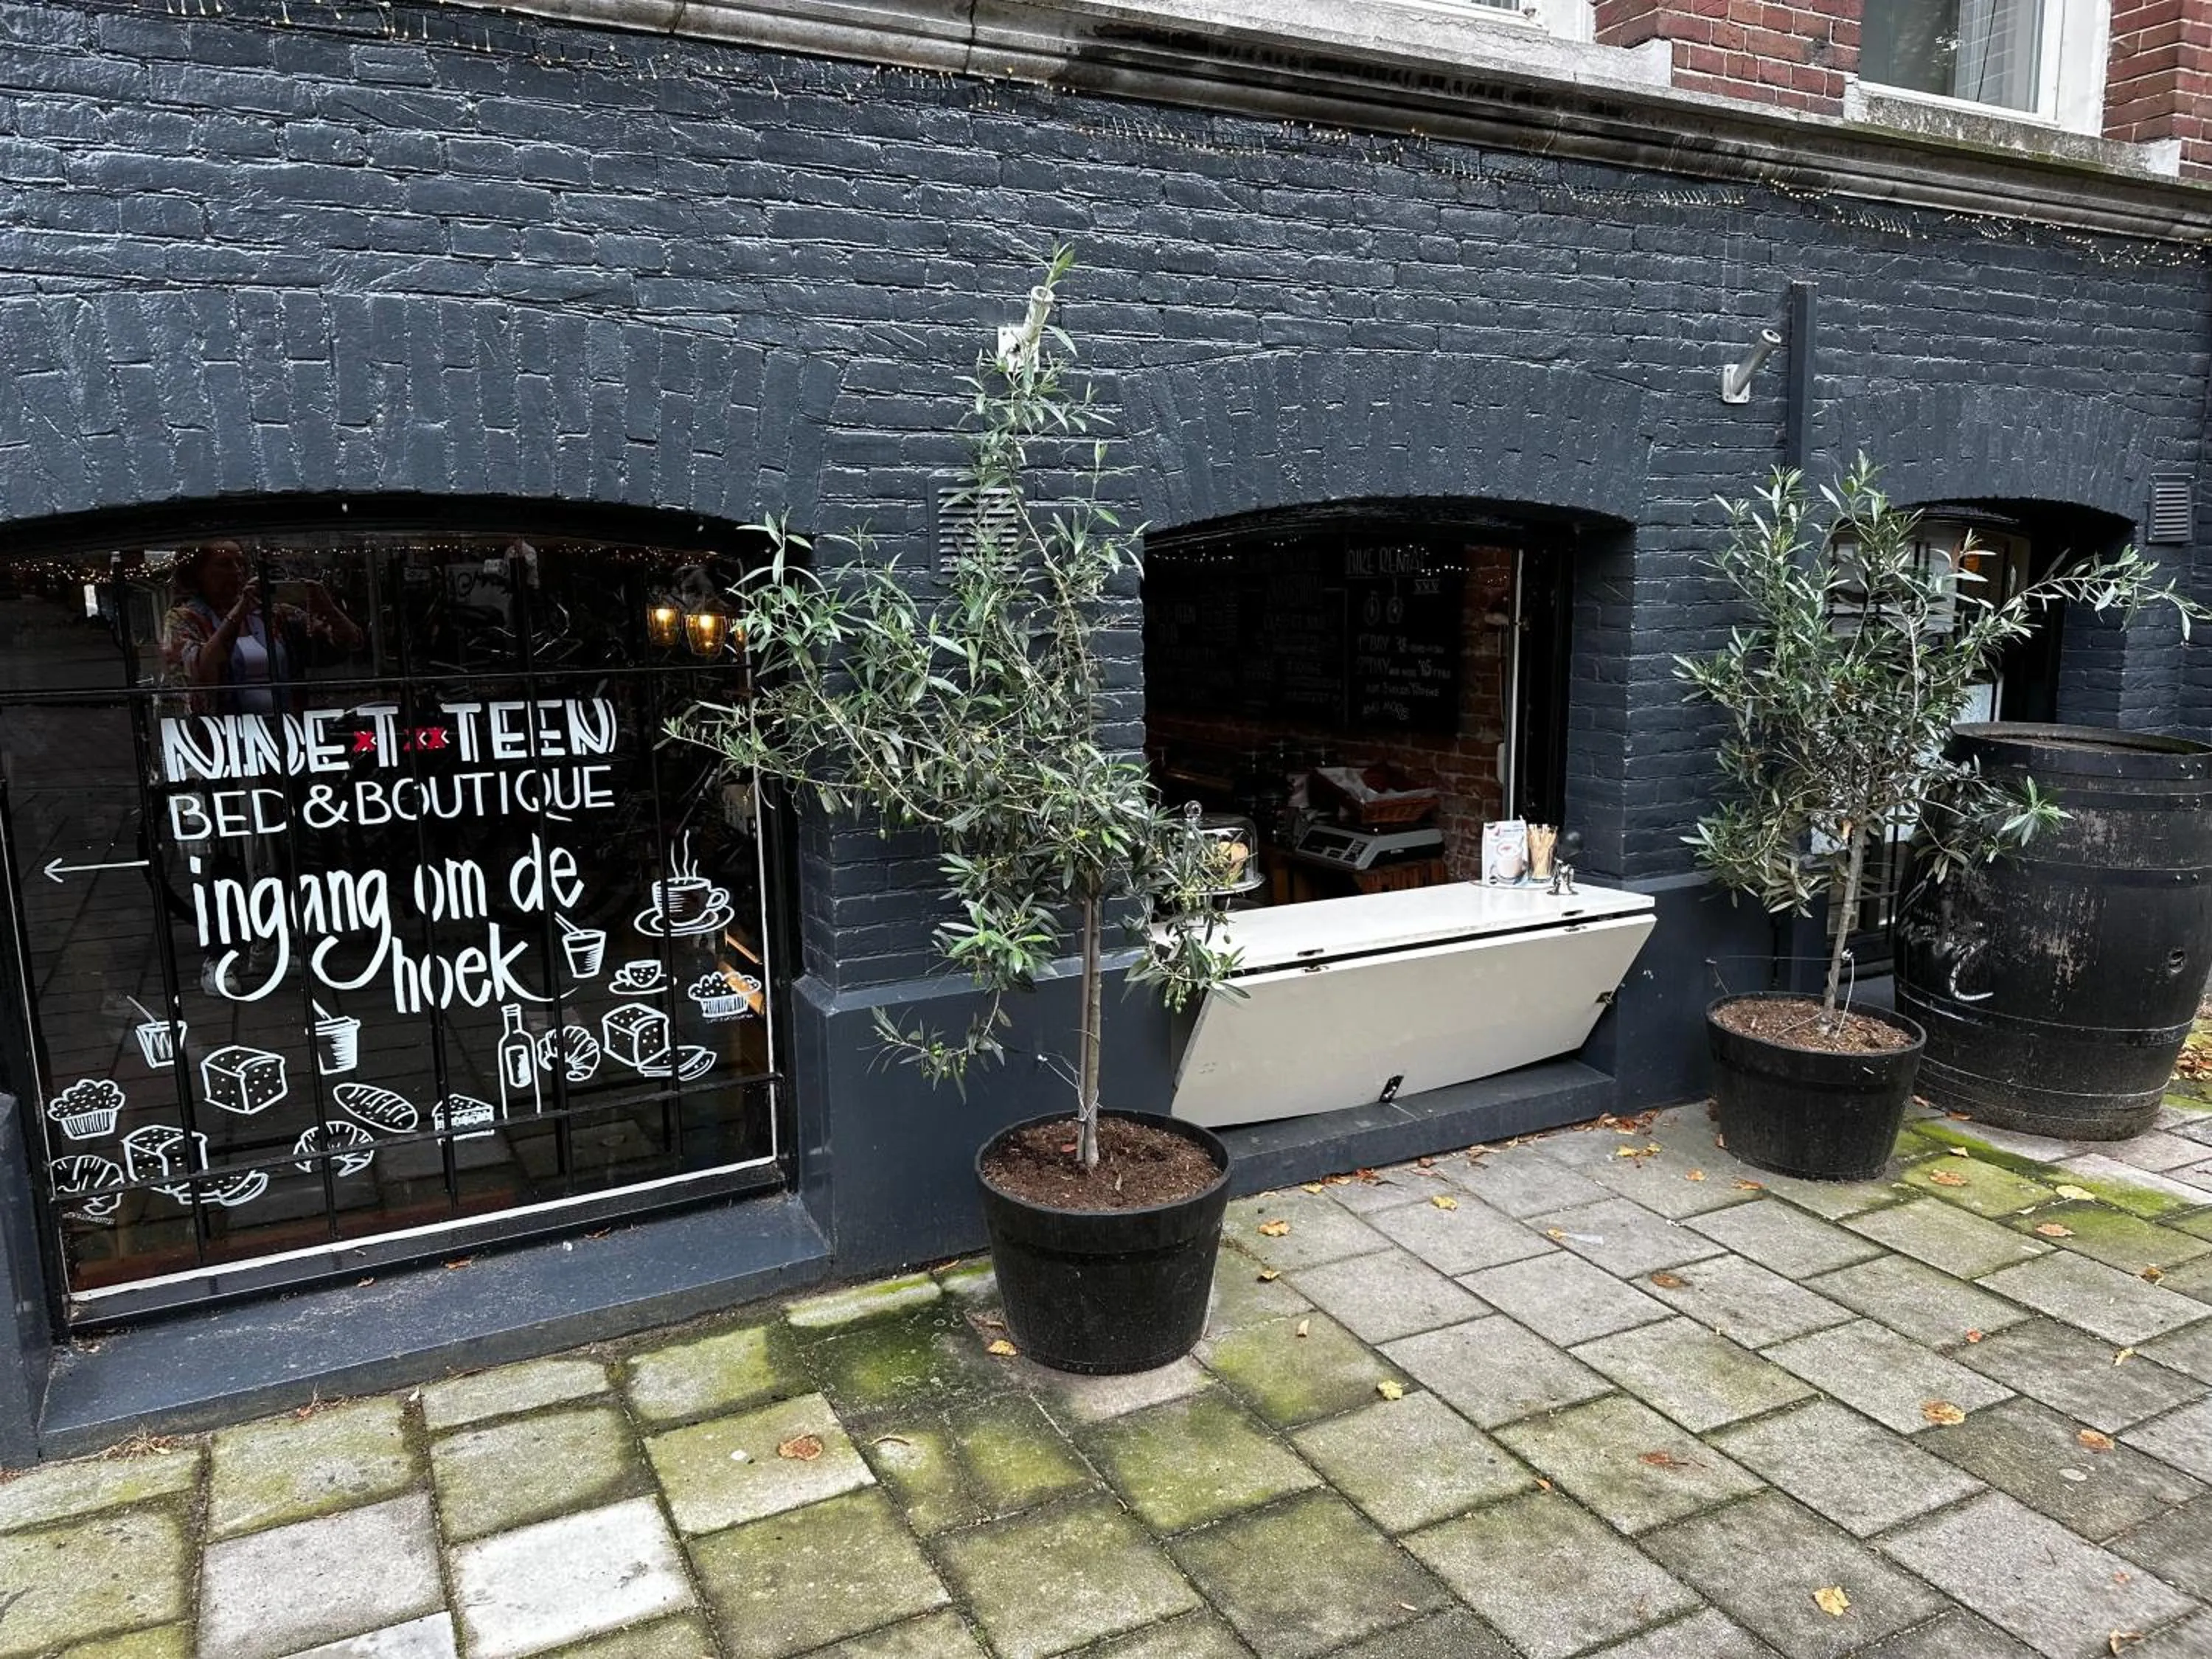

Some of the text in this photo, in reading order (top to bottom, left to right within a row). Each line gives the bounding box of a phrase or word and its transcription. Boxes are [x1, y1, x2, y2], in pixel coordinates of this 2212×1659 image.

[168, 788, 292, 841] BED
[189, 832, 585, 1002] ingang om de
[391, 922, 580, 1014] hoek
